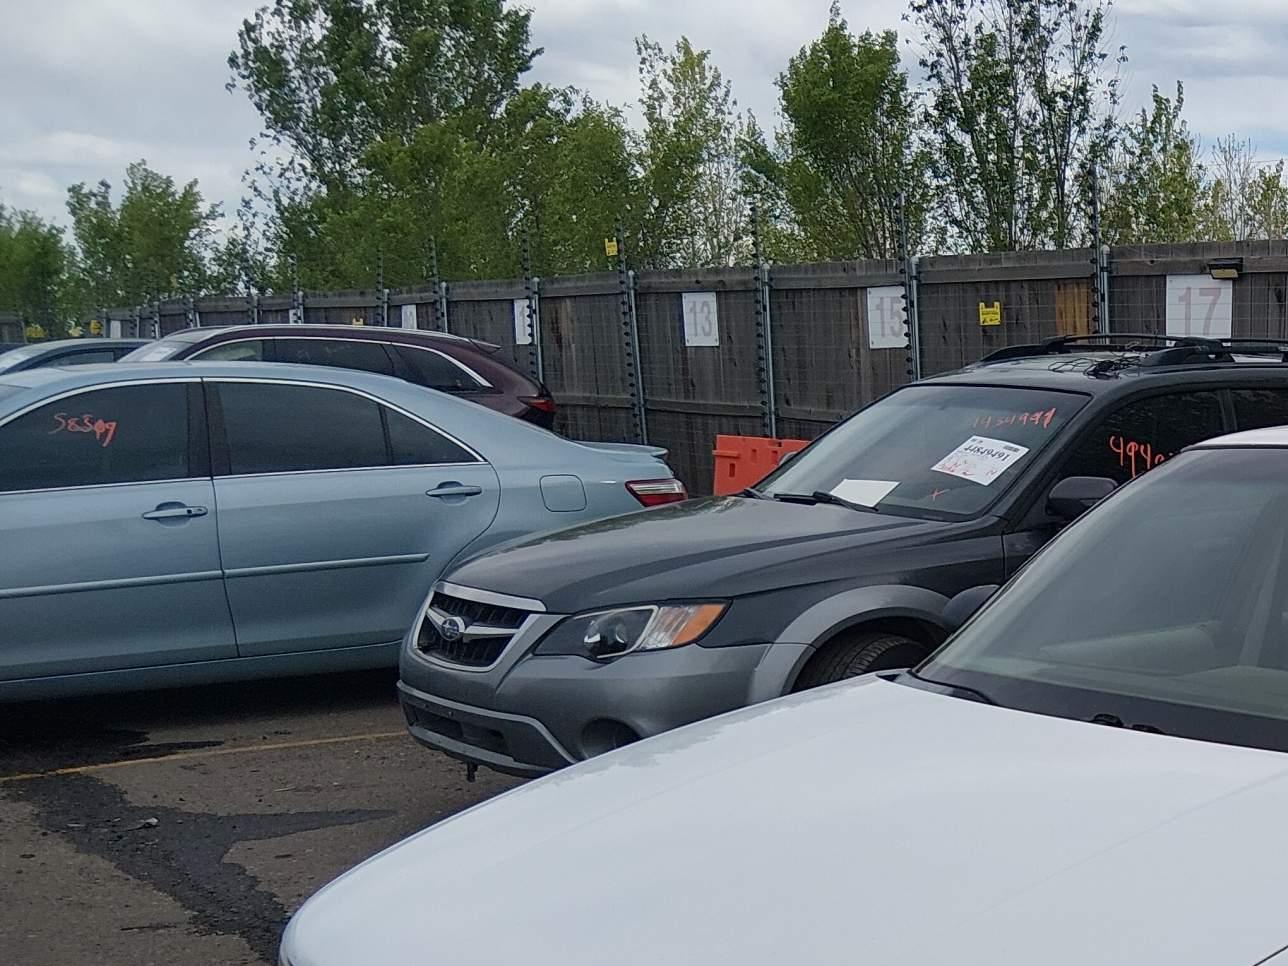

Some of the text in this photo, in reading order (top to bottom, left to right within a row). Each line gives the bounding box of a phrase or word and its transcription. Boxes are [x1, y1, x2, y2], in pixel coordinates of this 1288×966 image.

[689, 300, 713, 337] 13
[875, 296, 905, 338] 15
[1177, 286, 1222, 337] 17
